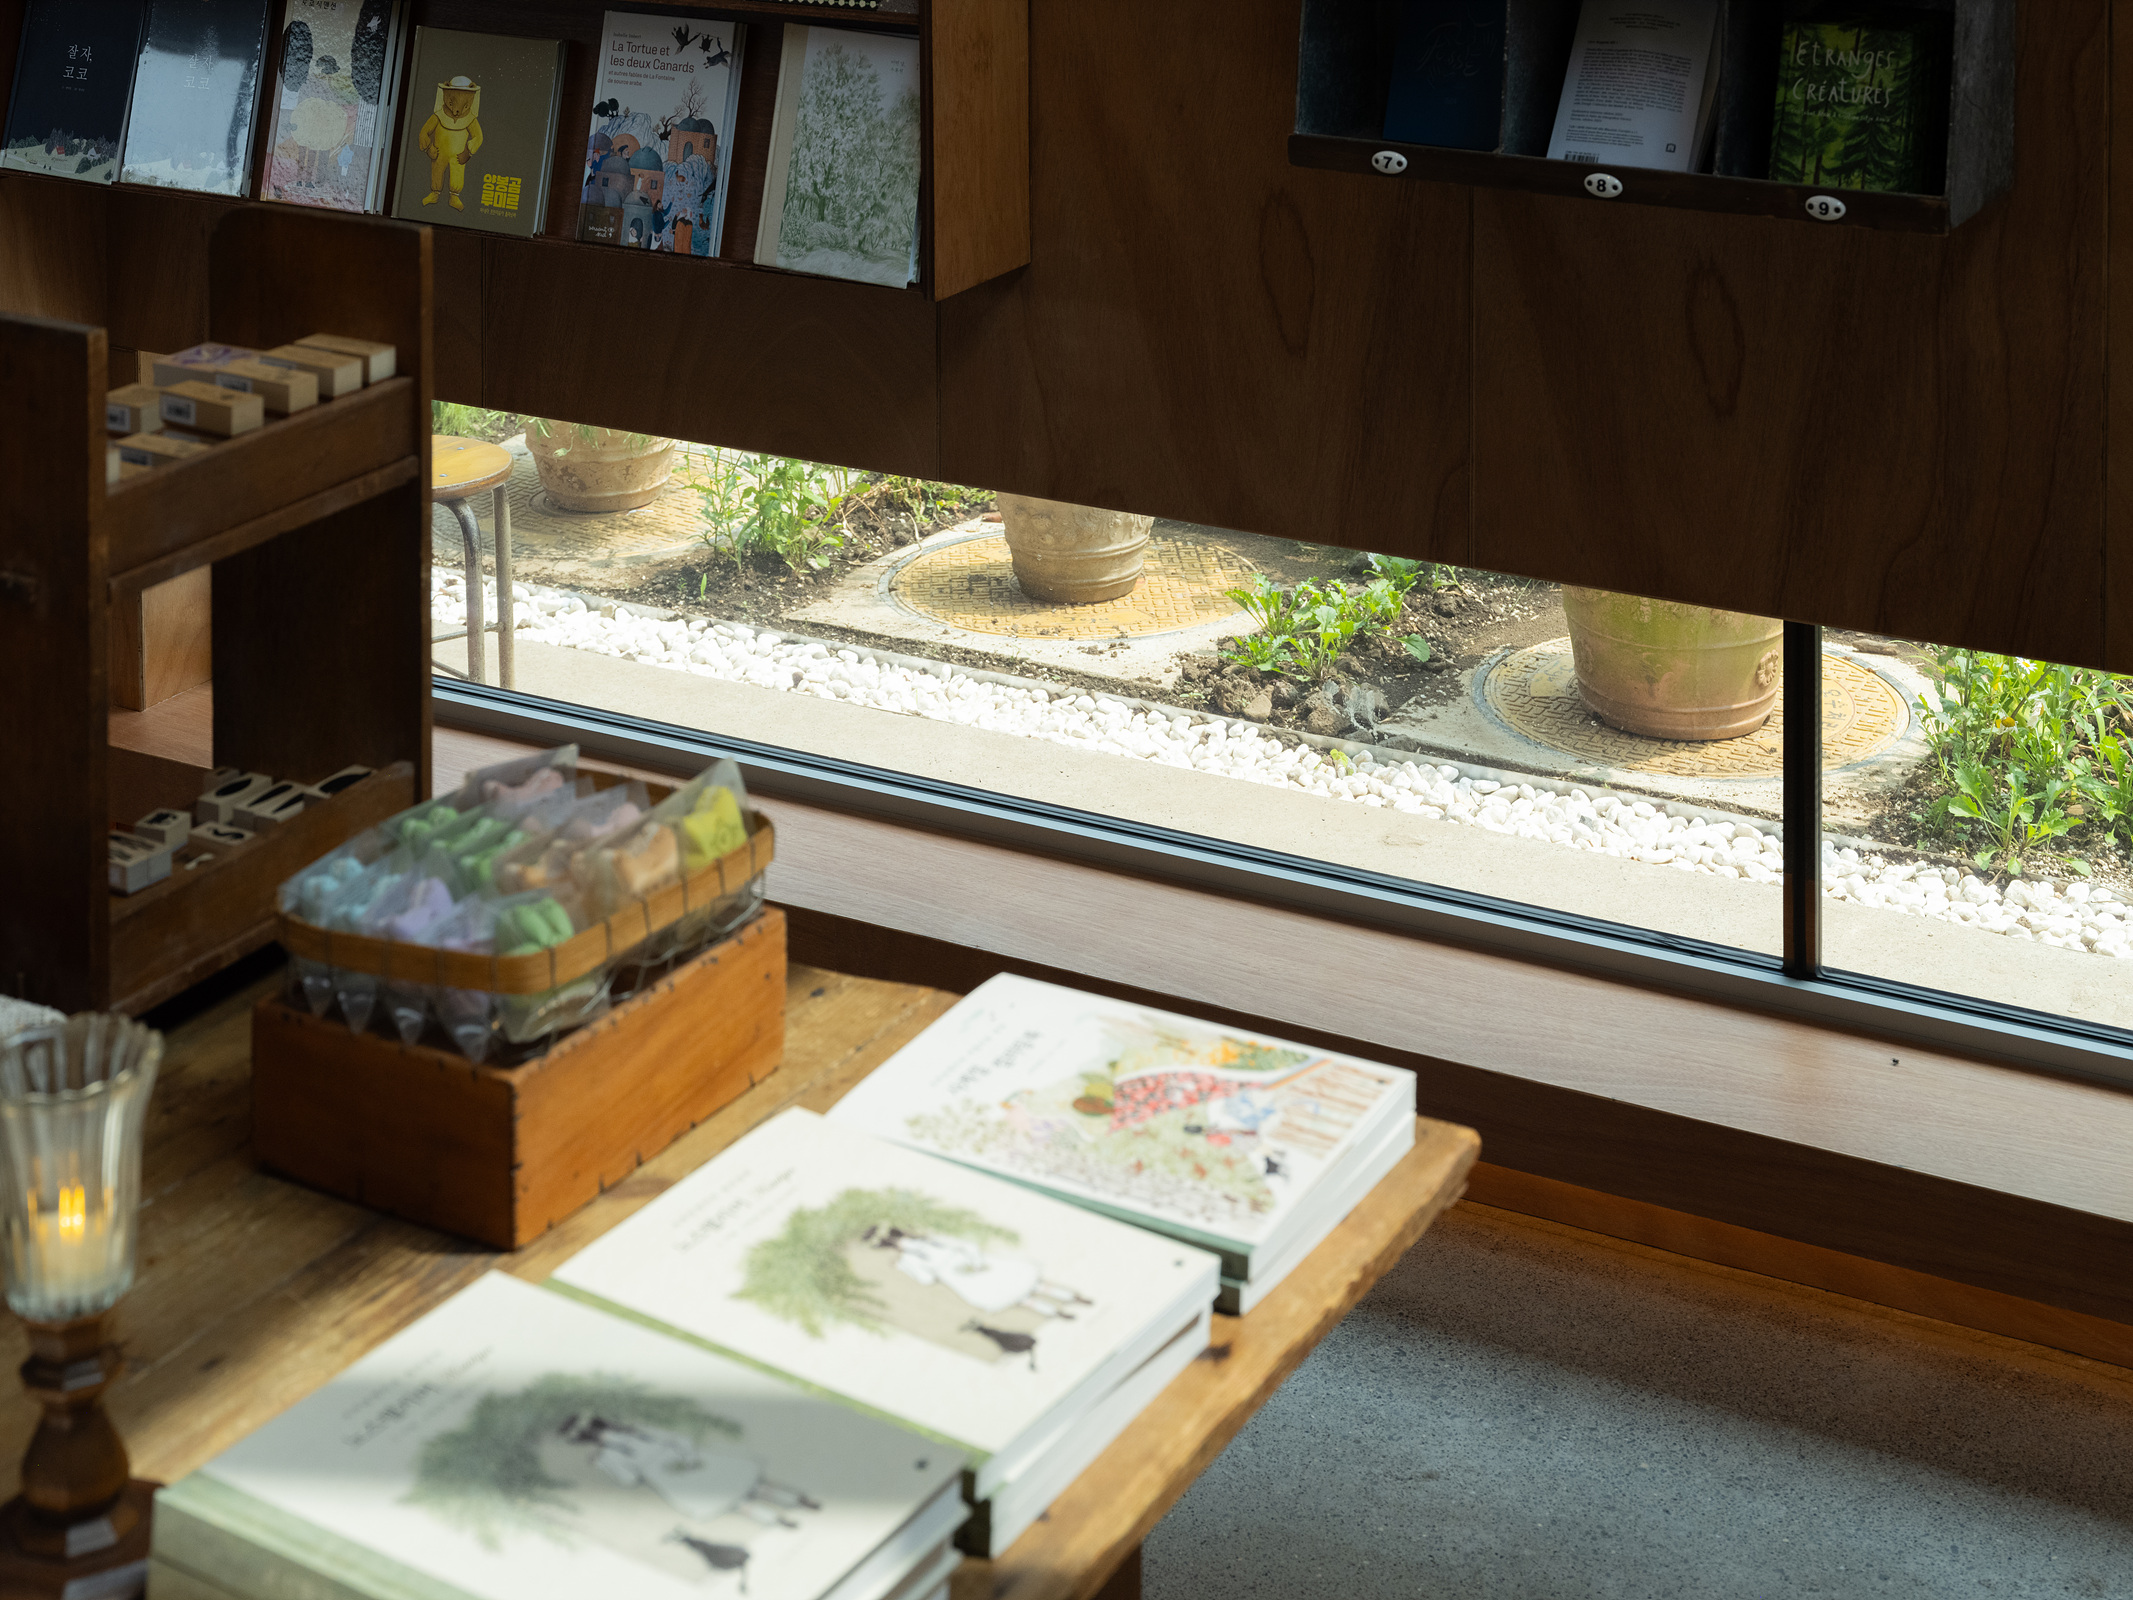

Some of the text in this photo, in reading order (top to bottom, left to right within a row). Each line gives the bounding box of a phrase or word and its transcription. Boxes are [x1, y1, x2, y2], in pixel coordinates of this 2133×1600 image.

[612, 40, 670, 56] La Tortue et
[610, 54, 695, 73] les deux Canards
[62, 65, 88, 81] 코코
[183, 75, 210, 90] 코코
[1383, 155, 1393, 169] 7
[482, 173, 522, 194] 양봉곰
[1596, 178, 1606, 192] 8
[1819, 201, 1829, 216] 9
